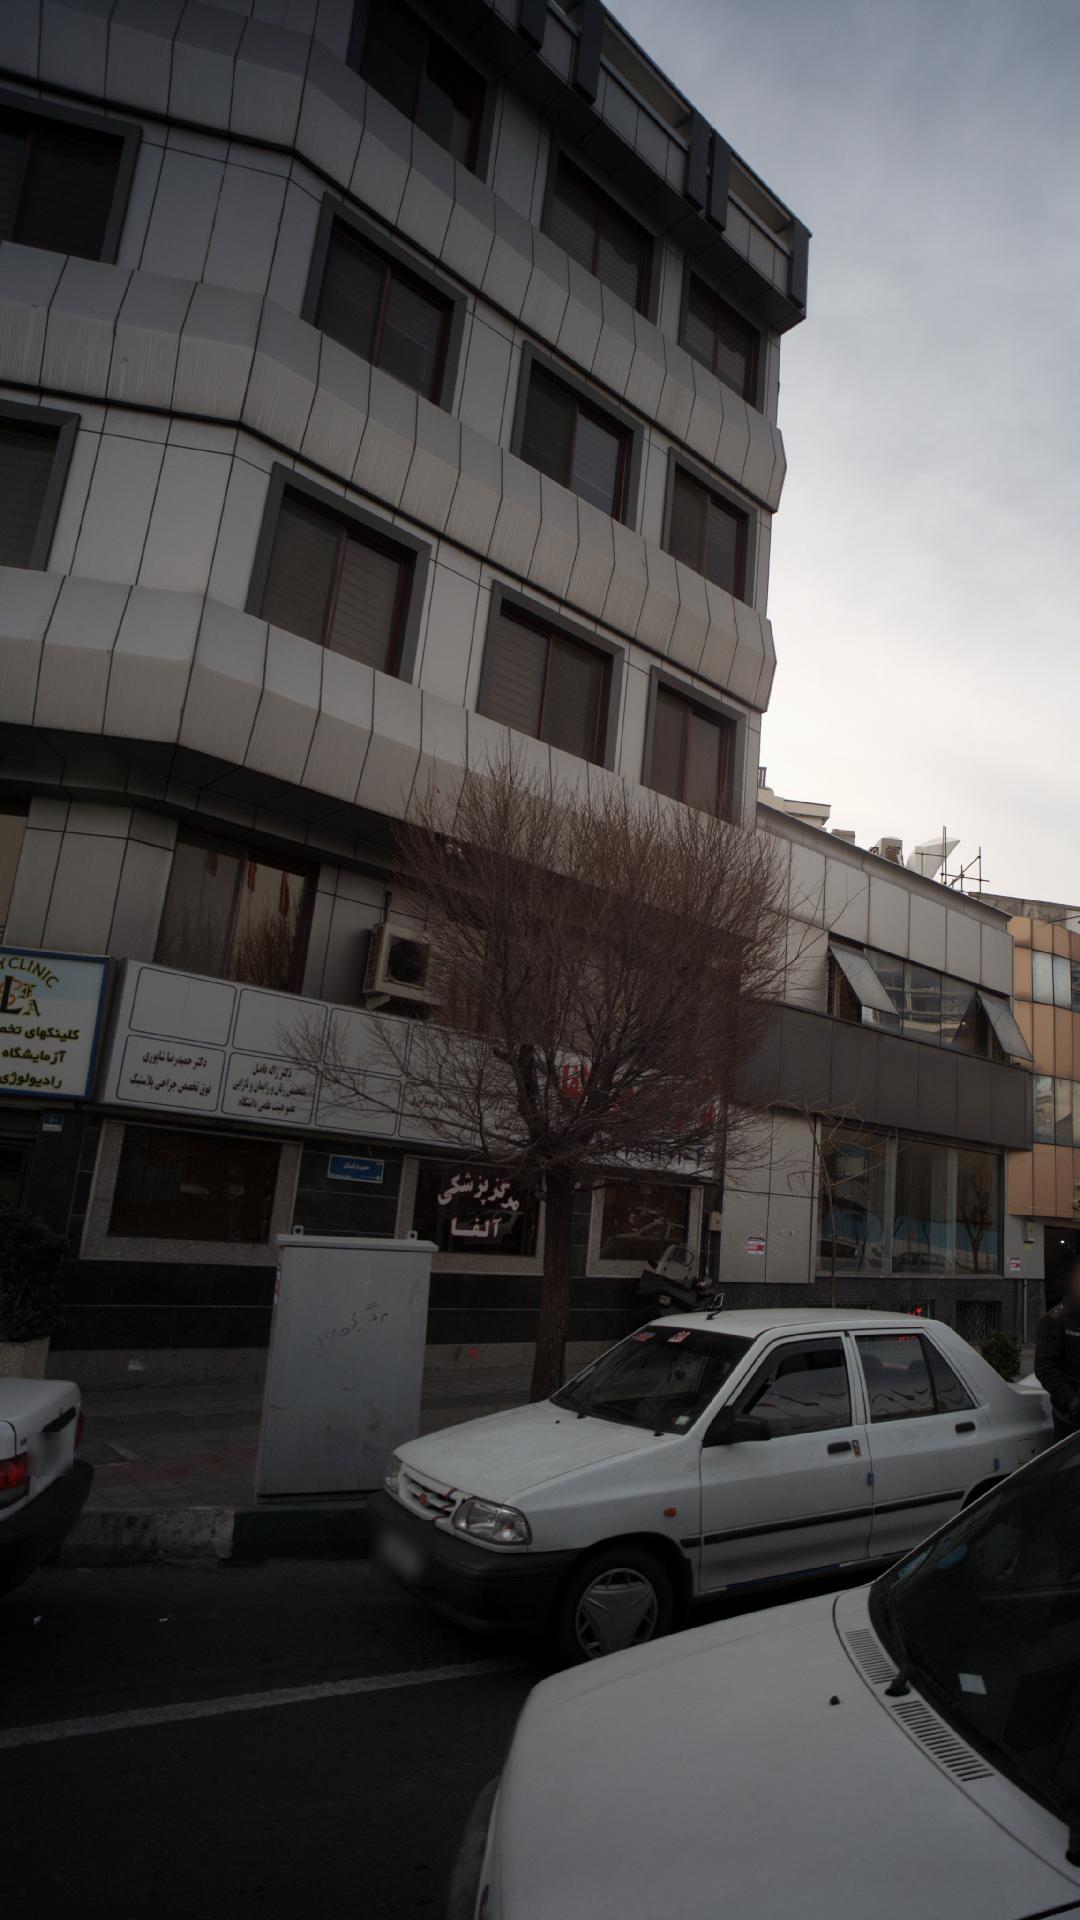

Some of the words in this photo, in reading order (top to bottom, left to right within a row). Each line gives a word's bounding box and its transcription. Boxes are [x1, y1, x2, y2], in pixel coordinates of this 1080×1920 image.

[2, 1046, 66, 1065] آزمایشگاه
[437, 1172, 488, 1206] پزشکی
[488, 1177, 520, 1210] مرکز
[450, 1216, 503, 1238] آلفا
